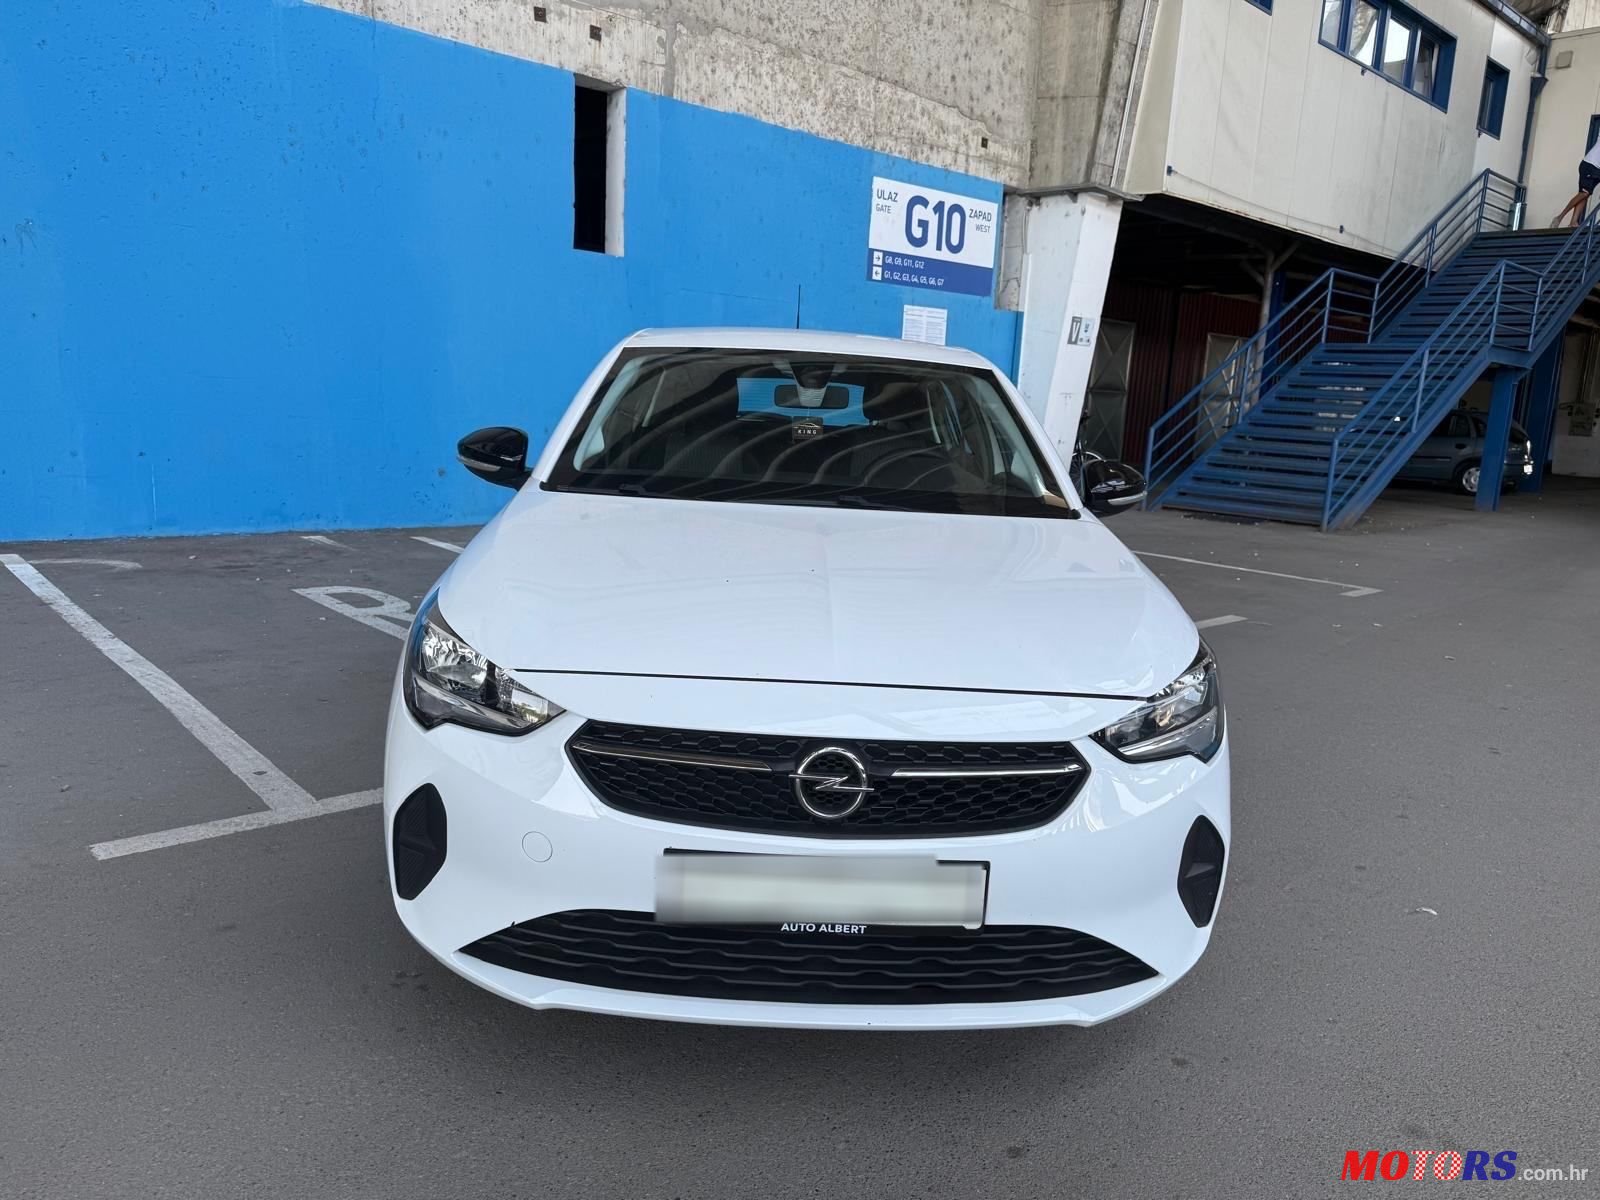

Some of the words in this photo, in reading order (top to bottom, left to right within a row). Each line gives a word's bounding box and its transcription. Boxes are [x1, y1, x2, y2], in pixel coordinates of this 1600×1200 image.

[876, 188, 898, 203] ULAZ
[875, 203, 892, 214] GATE
[968, 208, 992, 222] ZAPAD
[905, 195, 966, 254] G10
[975, 223, 991, 233] WEST
[903, 258, 914, 268] G11,
[914, 260, 925, 269] G12
[937, 278, 945, 286] G7
[781, 922, 816, 932] AUTO
[818, 923, 867, 934] ALBERT
